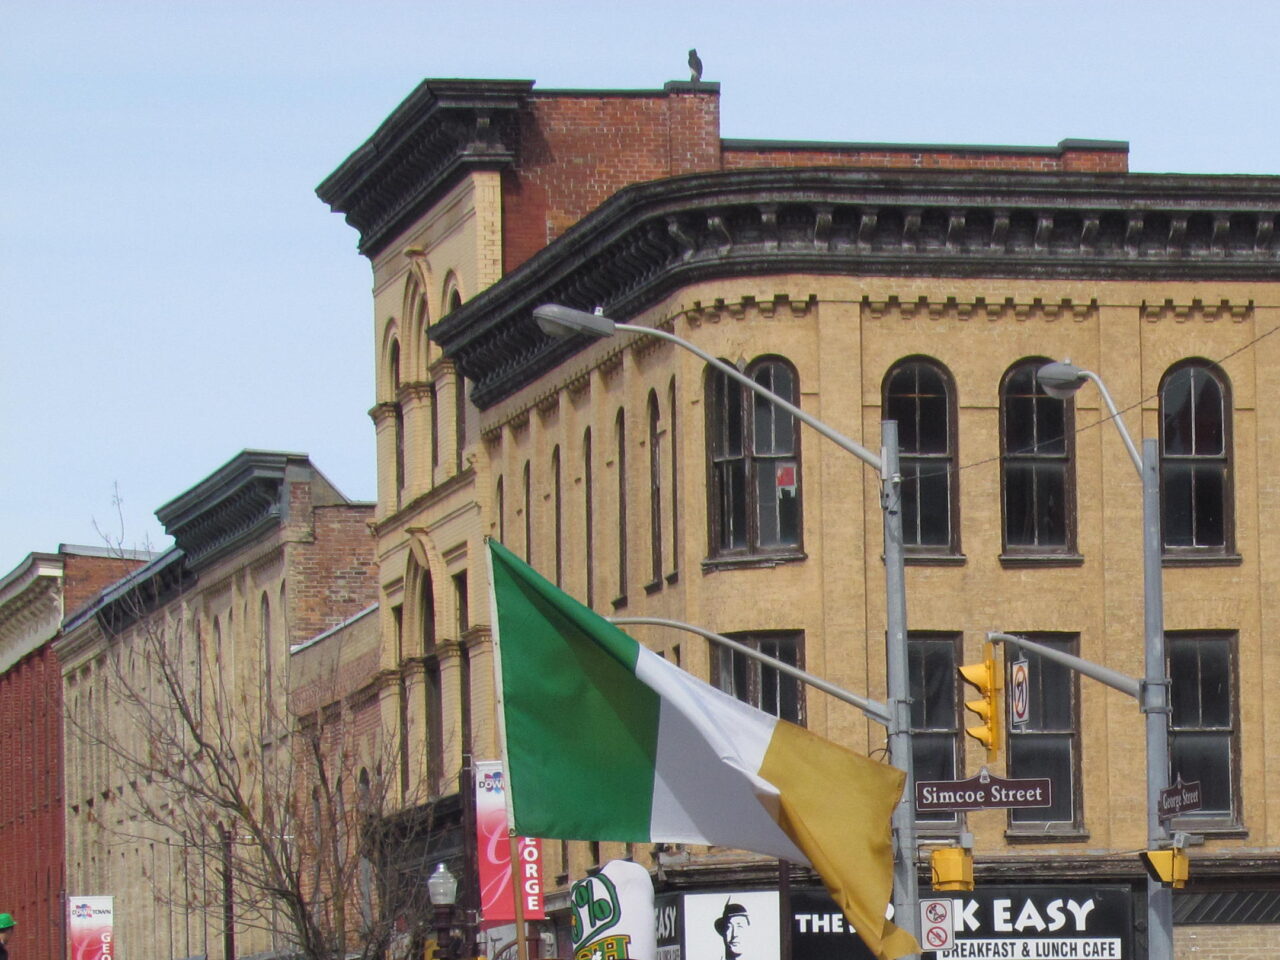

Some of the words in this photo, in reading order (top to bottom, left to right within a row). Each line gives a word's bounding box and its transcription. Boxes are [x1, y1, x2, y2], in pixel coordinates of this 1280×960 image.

[923, 786, 985, 803] Simcoe
[991, 785, 1043, 801] Street
[1162, 793, 1182, 812] George
[523, 837, 541, 911] EORGE
[795, 914, 844, 933] THE
[993, 898, 1095, 932] EASY
[1022, 943, 1031, 958] &
[1036, 942, 1078, 957] LUNCH
[1083, 942, 1116, 957] CAFE
